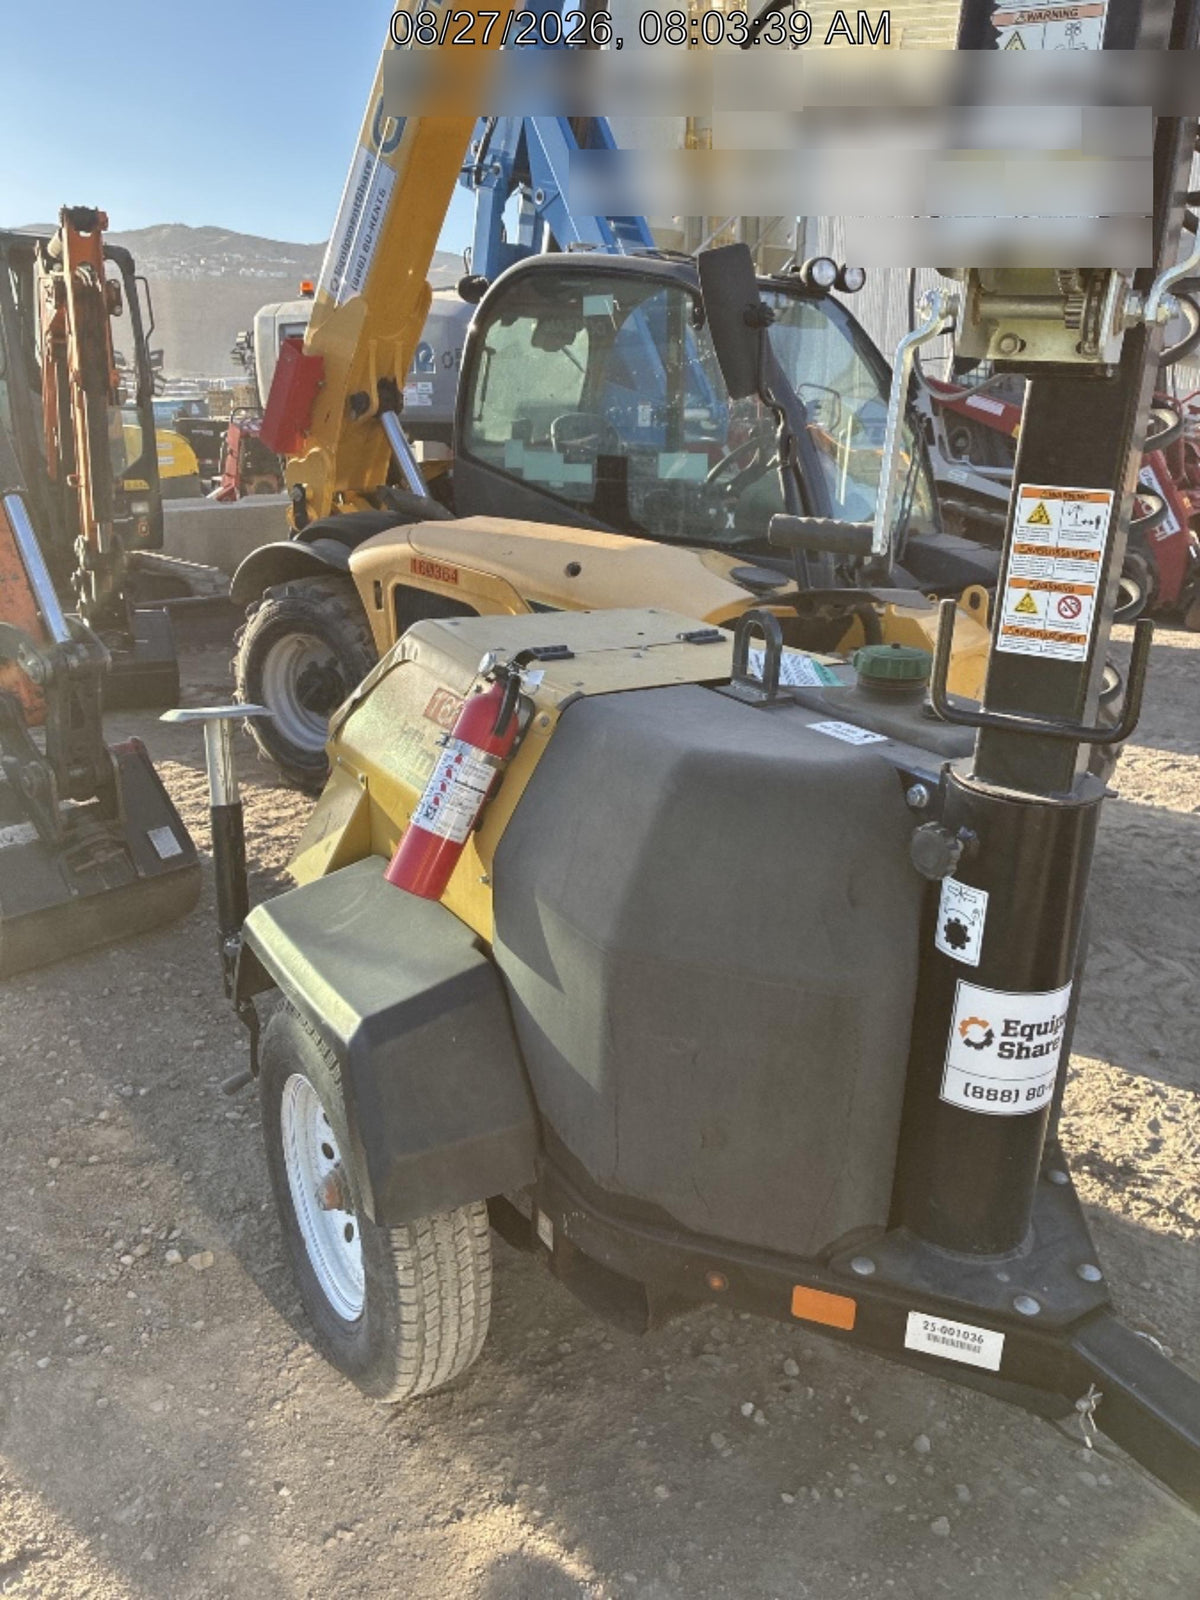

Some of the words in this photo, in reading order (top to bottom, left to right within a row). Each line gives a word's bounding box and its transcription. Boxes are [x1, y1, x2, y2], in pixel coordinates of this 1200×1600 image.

[1027, 8, 1079, 22] WARNING
[1001, 1013, 1067, 1042] Equip
[997, 1037, 1060, 1060] Share
[963, 1082, 1020, 1104] (888)
[922, 1320, 984, 1344] 25-001036
